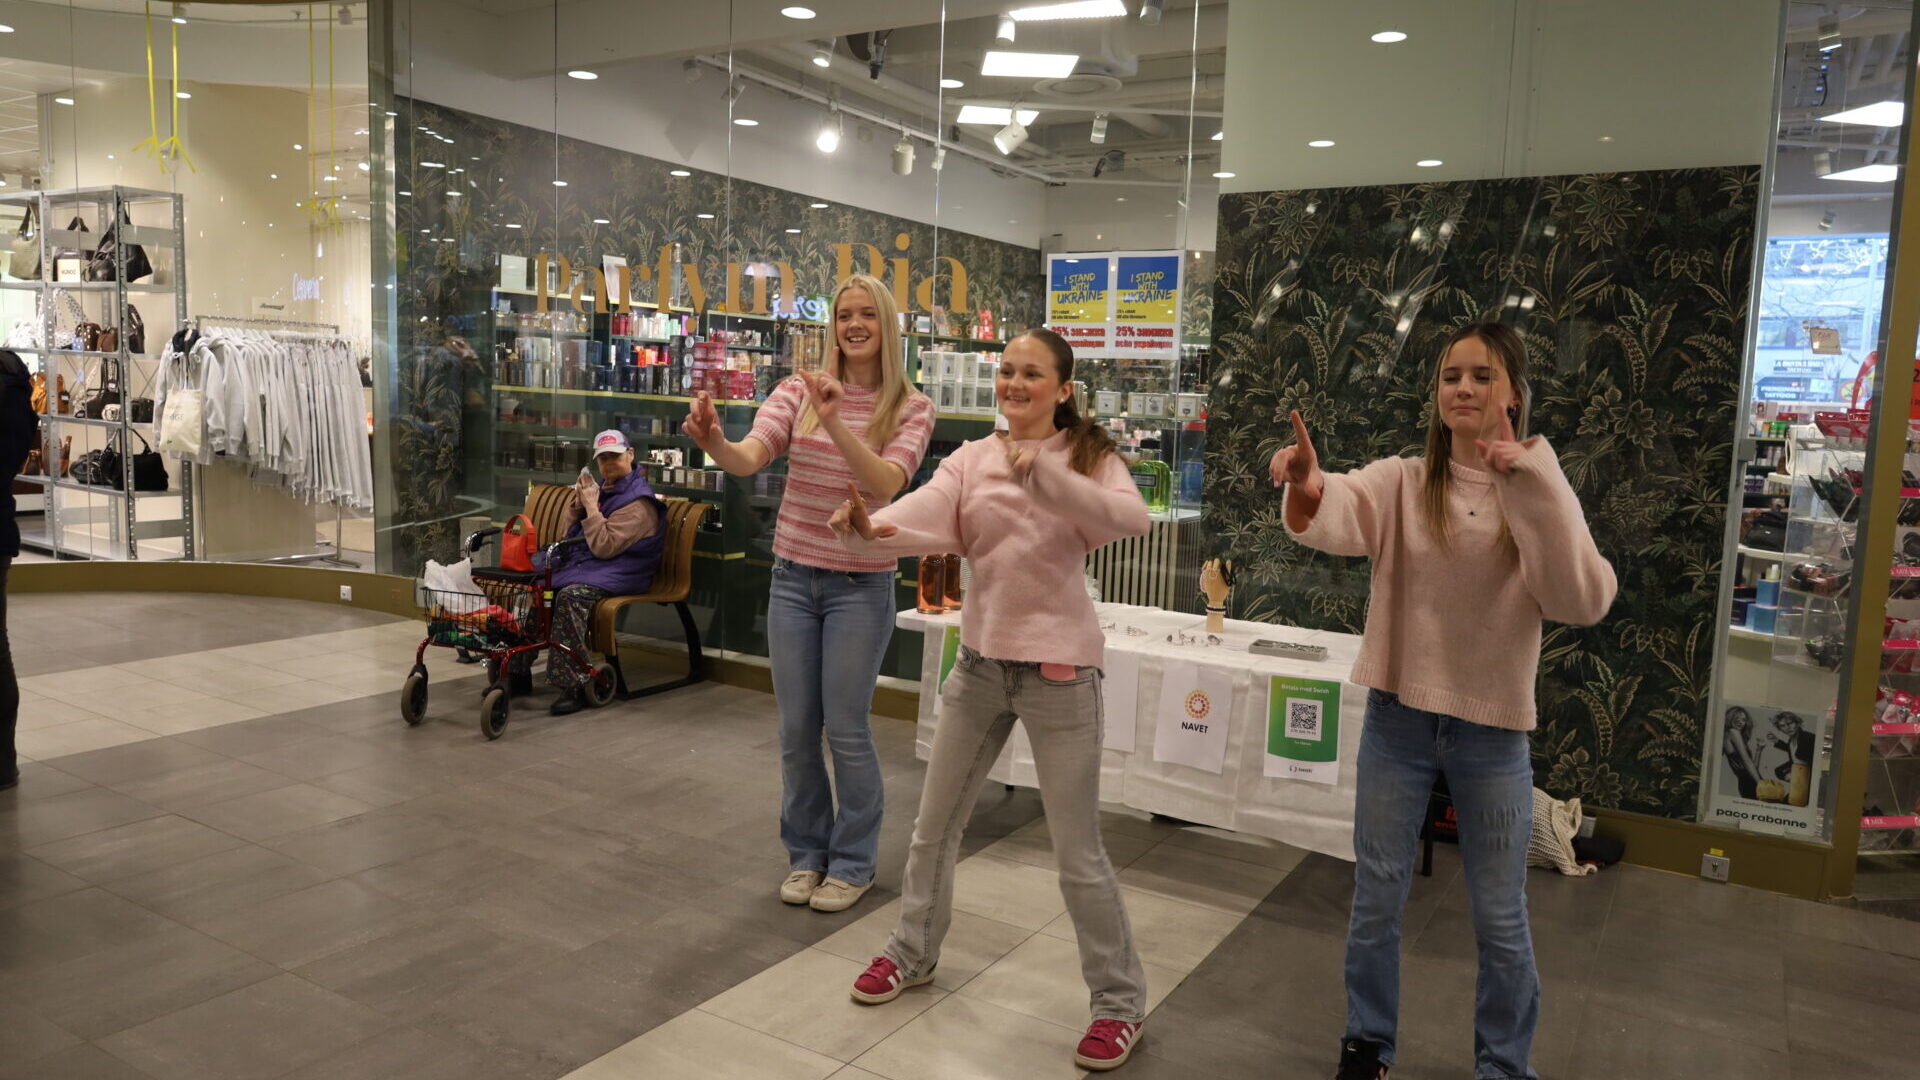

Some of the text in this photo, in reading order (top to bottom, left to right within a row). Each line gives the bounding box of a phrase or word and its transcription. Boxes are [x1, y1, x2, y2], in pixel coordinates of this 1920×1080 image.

[1069, 272, 1095, 284] STAND
[1136, 271, 1164, 283] STAND
[533, 241, 797, 333] Parfym
[1071, 283, 1089, 291] WITH
[1138, 281, 1157, 291] WITH
[1057, 290, 1103, 304] UKRAINE
[1123, 289, 1172, 304] UKRAINE
[1115, 326, 1135, 337] 25%
[1181, 721, 1209, 734] NAVET
[1716, 808, 1807, 829] paco rabanne
